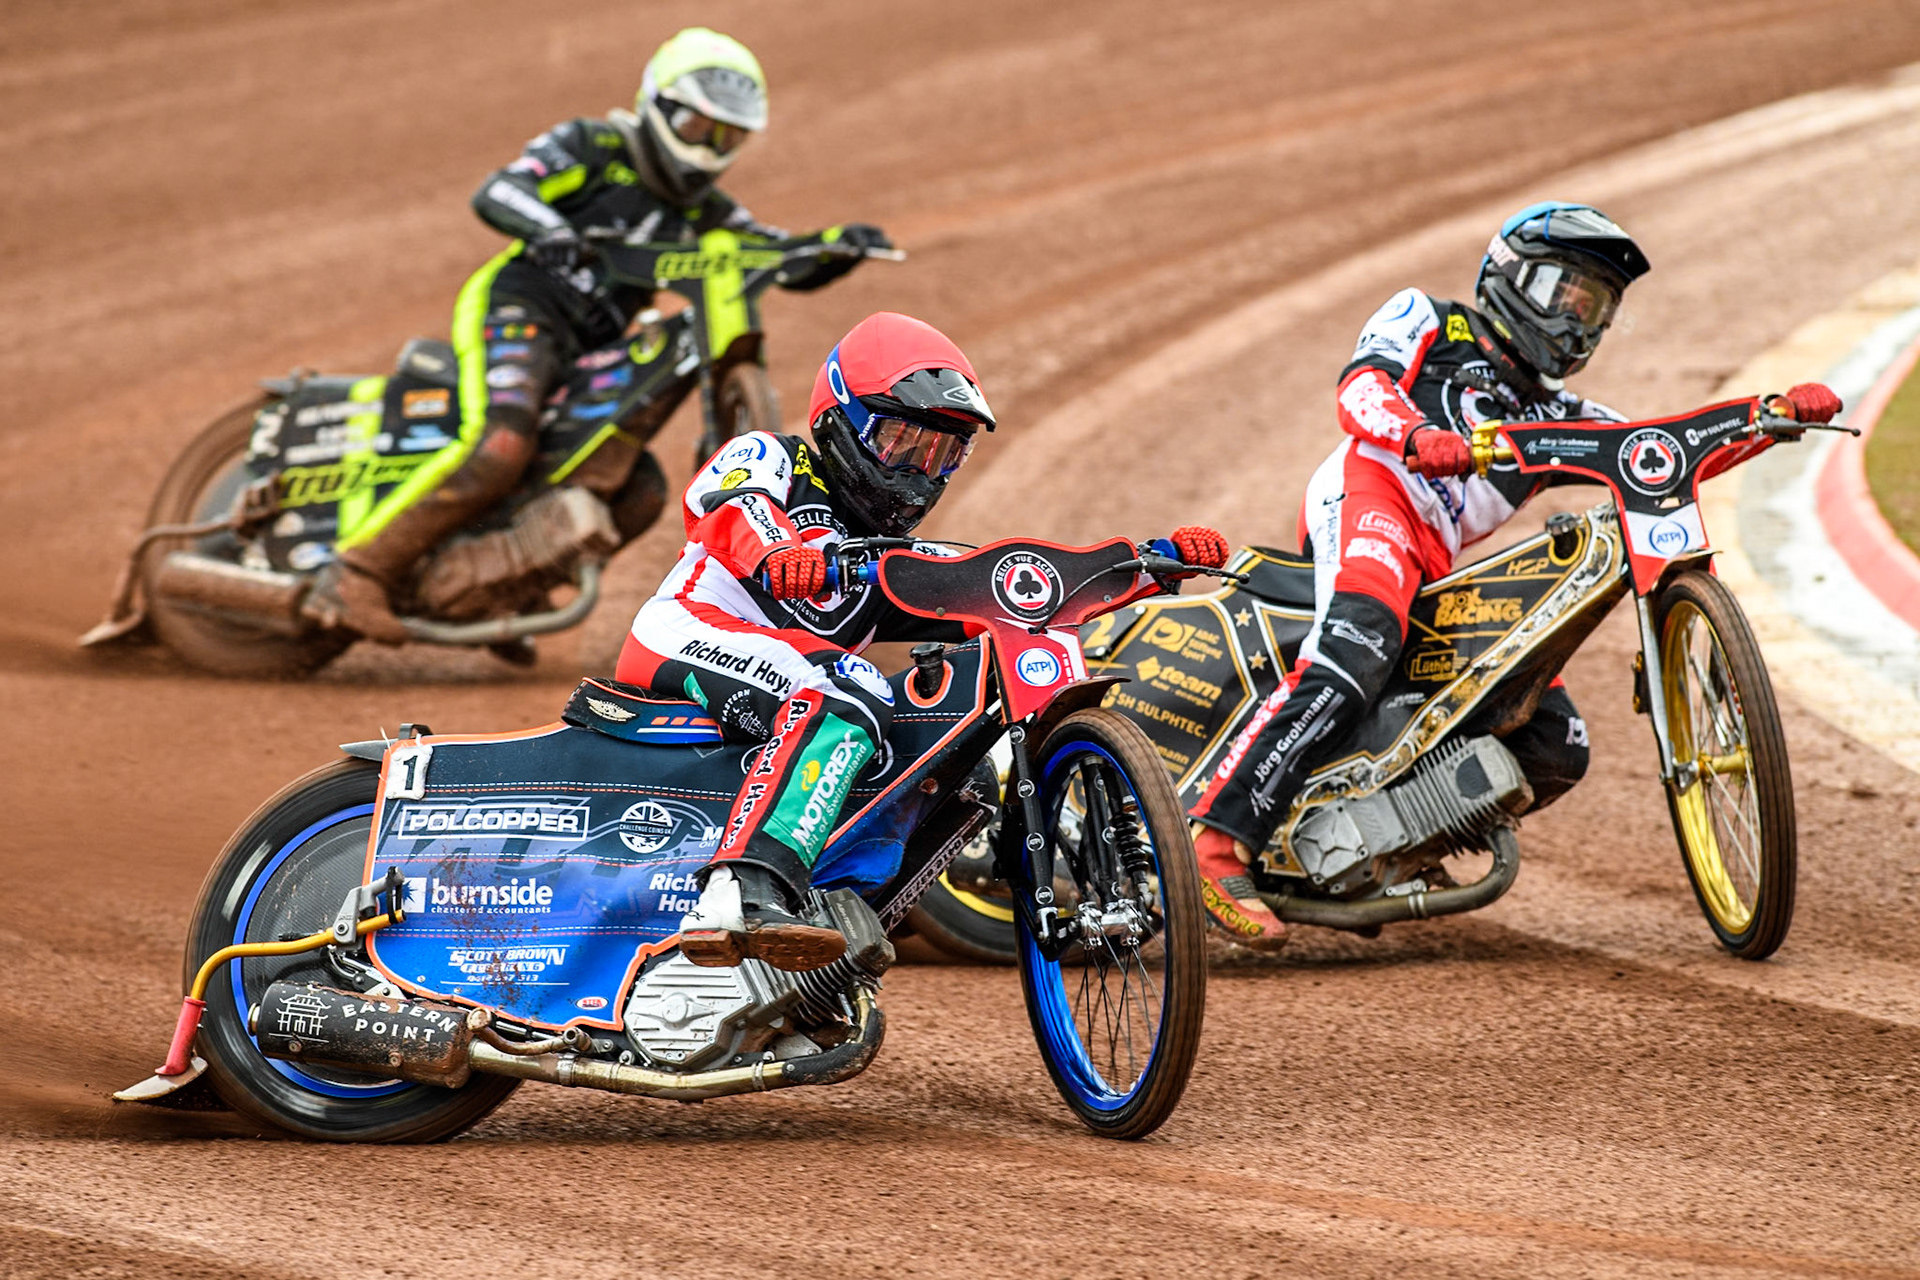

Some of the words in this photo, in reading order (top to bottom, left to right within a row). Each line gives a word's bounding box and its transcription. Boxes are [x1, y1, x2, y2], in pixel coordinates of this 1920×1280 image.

[1622, 436, 1639, 460] BELLE
[1660, 437, 1679, 454] ACES
[788, 511, 832, 530] BELLE
[1656, 531, 1682, 544] ATPI
[995, 559, 1014, 582] BELLE
[1014, 555, 1033, 563] VUE
[1035, 560, 1056, 579] ACES
[1434, 602, 1523, 627] RACING
[679, 640, 754, 674] Richard
[1025, 661, 1053, 673] ATPI
[1159, 666, 1222, 700] team
[721, 689, 751, 722] EASTERN
[1117, 693, 1137, 709] SH
[1254, 751, 1282, 783] Jörg
[1276, 686, 1335, 752] Grohmann
[403, 754, 418, 791] 1
[791, 732, 859, 847] MOTOREX
[804, 834, 819, 854] Oil
[819, 817, 829, 833] of
[826, 743, 867, 817] Switzerland
[409, 812, 579, 833] POLCOPPER
[619, 823, 648, 832] CHALLENGE
[648, 827, 664, 835] COINS
[431, 878, 553, 905] burnside
[431, 906, 483, 914] chartered
[487, 906, 551, 914] accountants
[1200, 877, 1266, 937] aytona
[505, 948, 566, 965] BROWN
[341, 1002, 458, 1032] EASTERN
[355, 1018, 436, 1042] POINT
